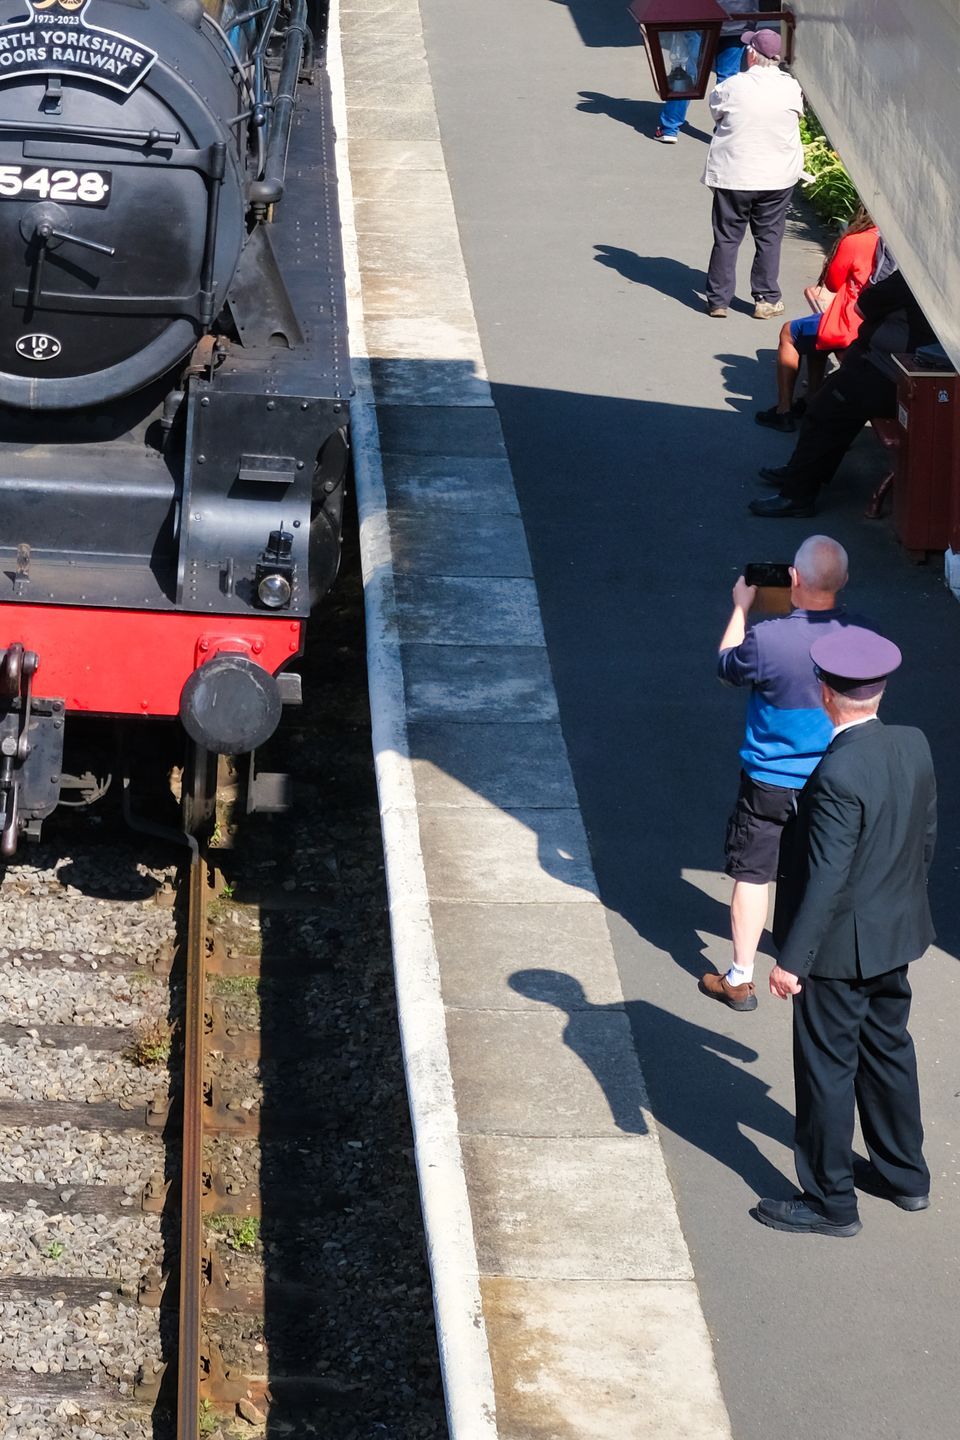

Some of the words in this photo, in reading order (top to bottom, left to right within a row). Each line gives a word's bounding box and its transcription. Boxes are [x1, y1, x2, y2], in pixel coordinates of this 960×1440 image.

[34, 14, 80, 25] 1973-2023
[40, 30, 145, 67] YORKSHIRE
[52, 47, 129, 76] RAILWAY
[32, 336, 48, 349] 10
